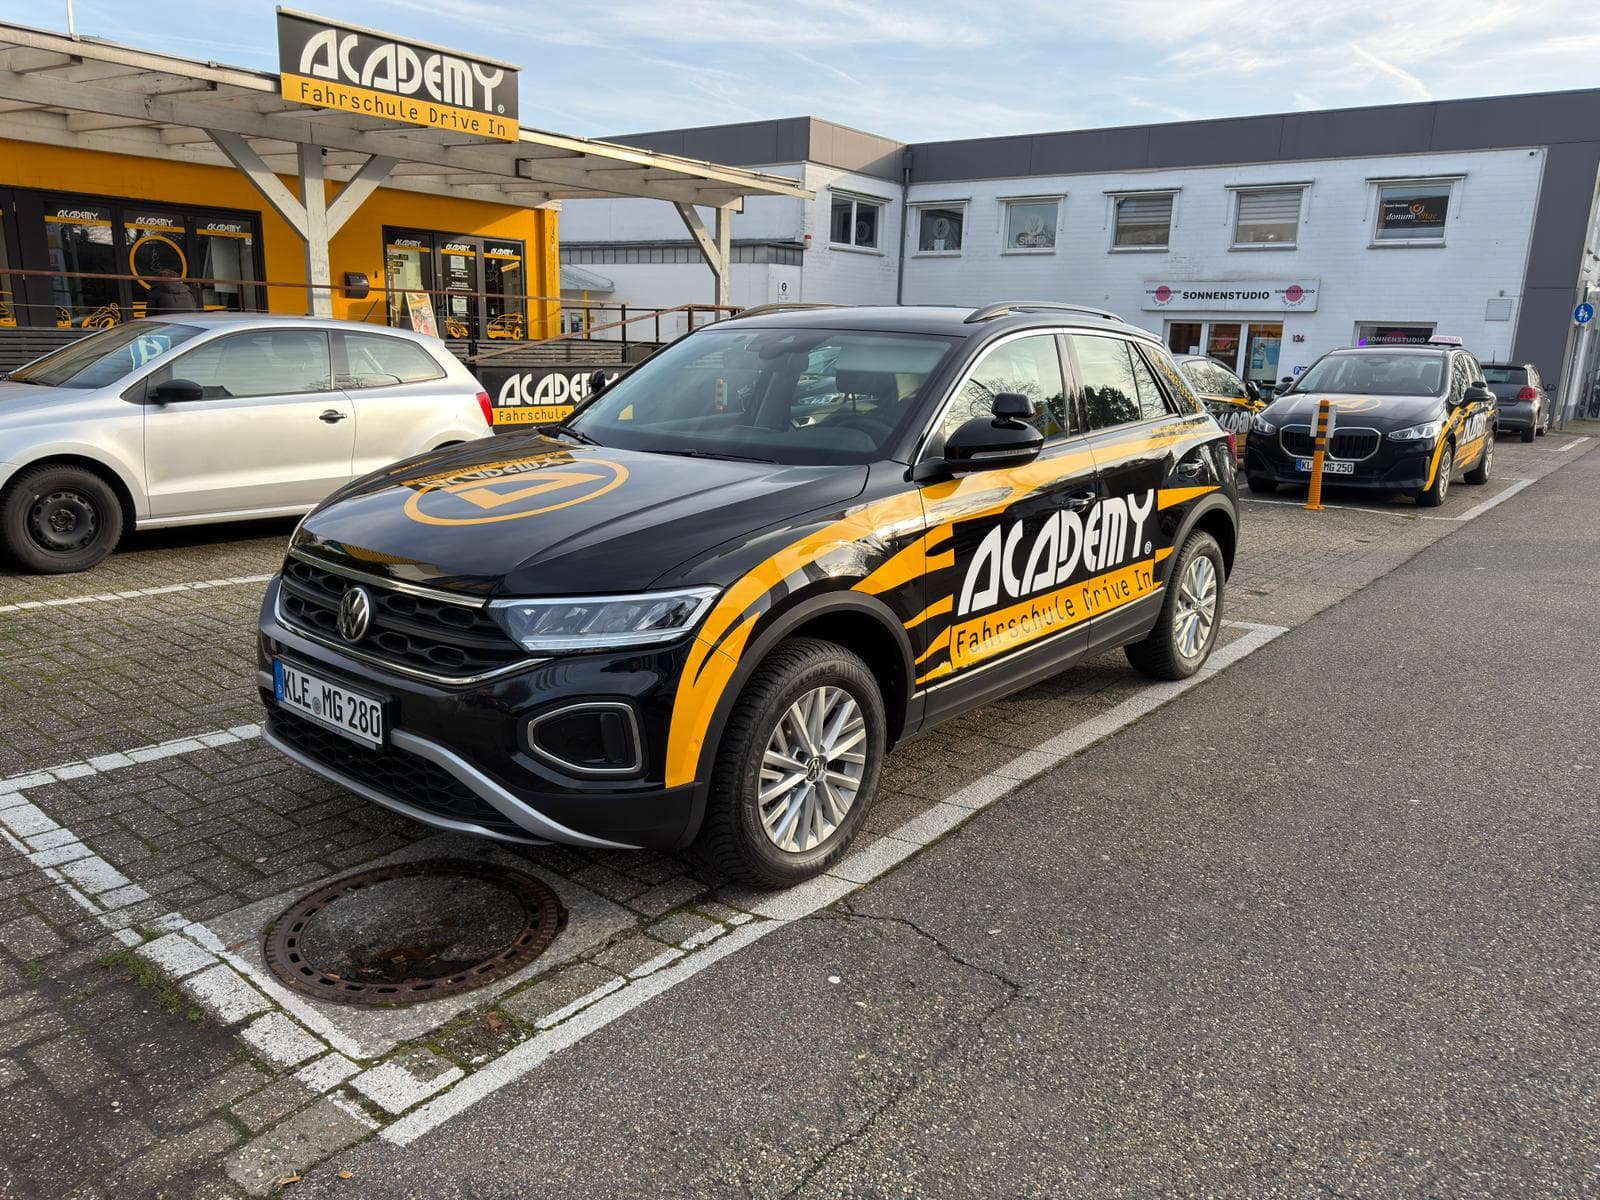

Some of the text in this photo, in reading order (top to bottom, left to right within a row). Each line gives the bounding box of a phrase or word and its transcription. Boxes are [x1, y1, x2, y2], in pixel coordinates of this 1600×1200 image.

[300, 82, 506, 137] Fahrschule Drive In
[1182, 291, 1270, 300] SONNENSTUDIO
[1292, 334, 1305, 343] 136
[498, 373, 619, 407] ACADE
[499, 410, 568, 423] Fahrschule
[1301, 459, 1314, 471] KL
[1336, 462, 1353, 473] 250
[956, 568, 1154, 659] Fahrschule Drive In
[283, 668, 312, 710] KLE
[322, 685, 344, 724] MG
[347, 700, 382, 738] 280
